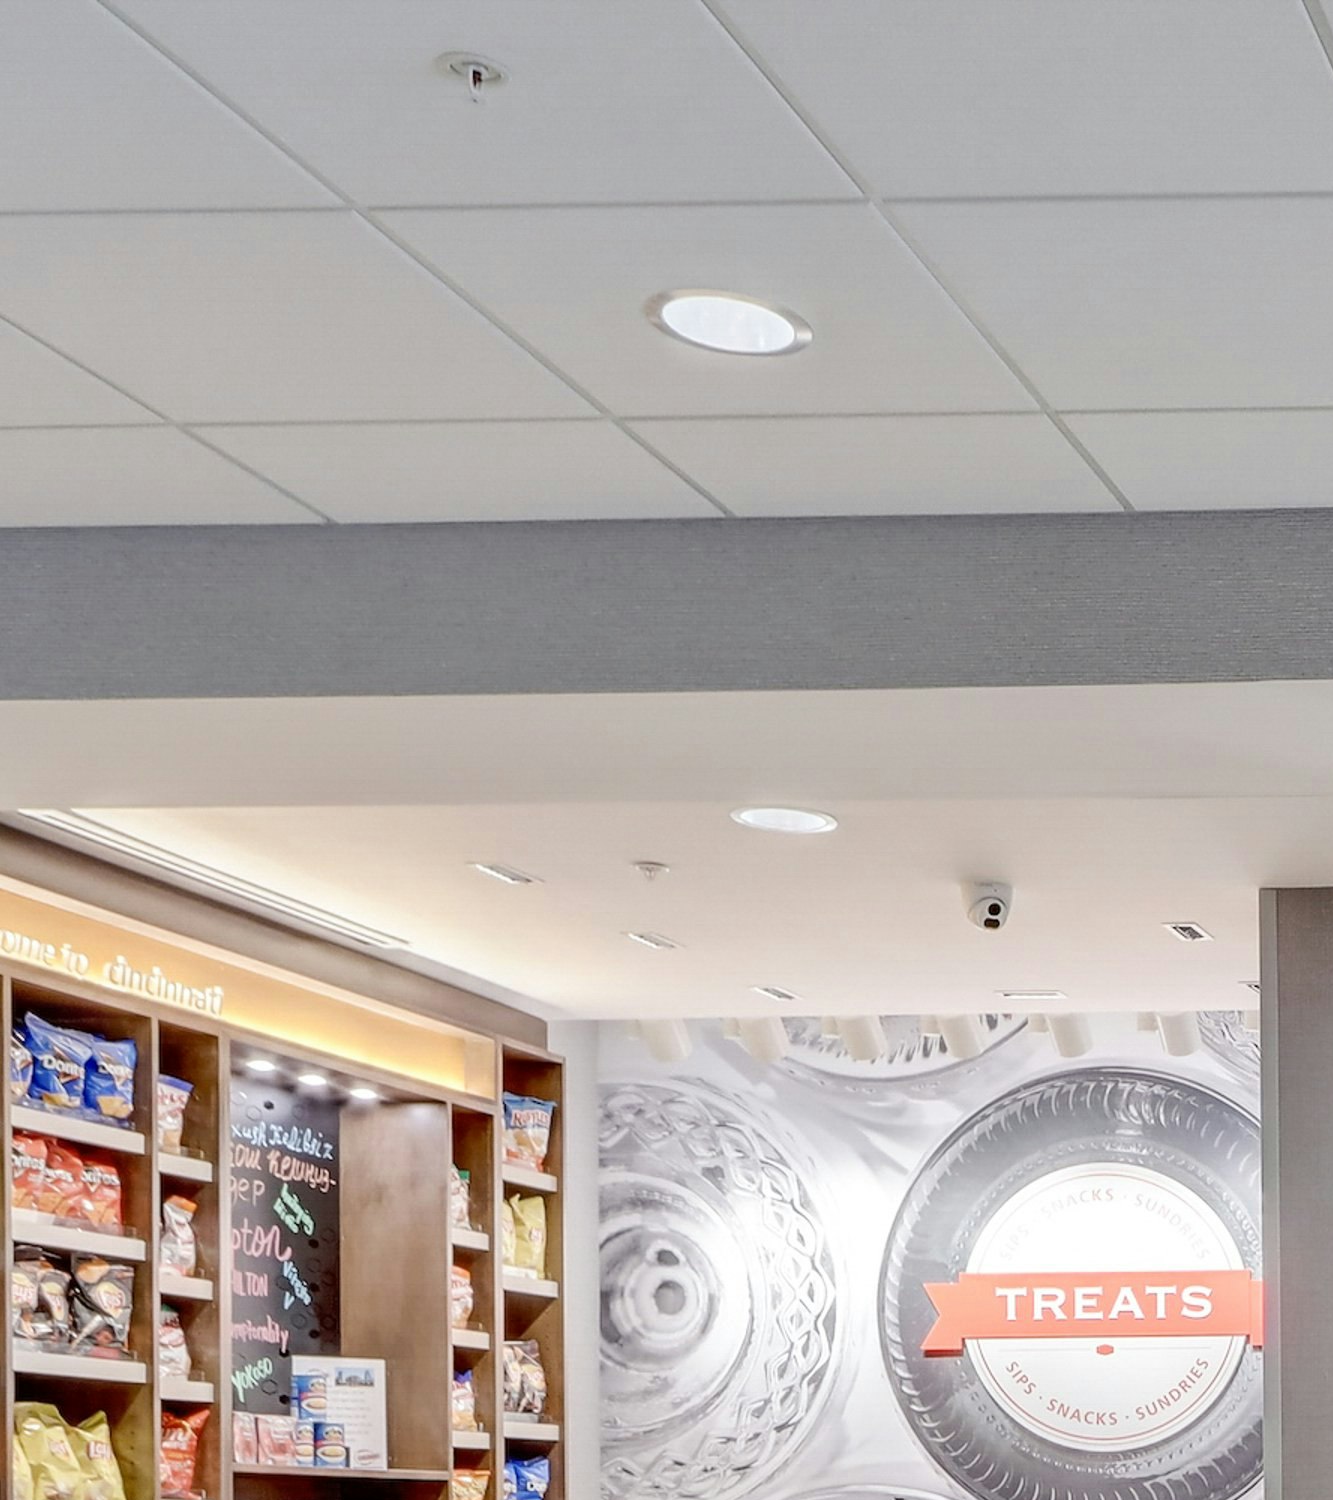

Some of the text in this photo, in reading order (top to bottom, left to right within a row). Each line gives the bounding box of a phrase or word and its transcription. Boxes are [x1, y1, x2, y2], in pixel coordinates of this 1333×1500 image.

[61, 943, 89, 975] to
[103, 955, 224, 1015] cincinnati
[1040, 1188, 1115, 1218] SNACKS
[1134, 1193, 1211, 1260] SUNDRIES
[994, 1285, 1213, 1321] TREATS
[1005, 1358, 1210, 1426] SIPS SNACKS SUNDRIES
